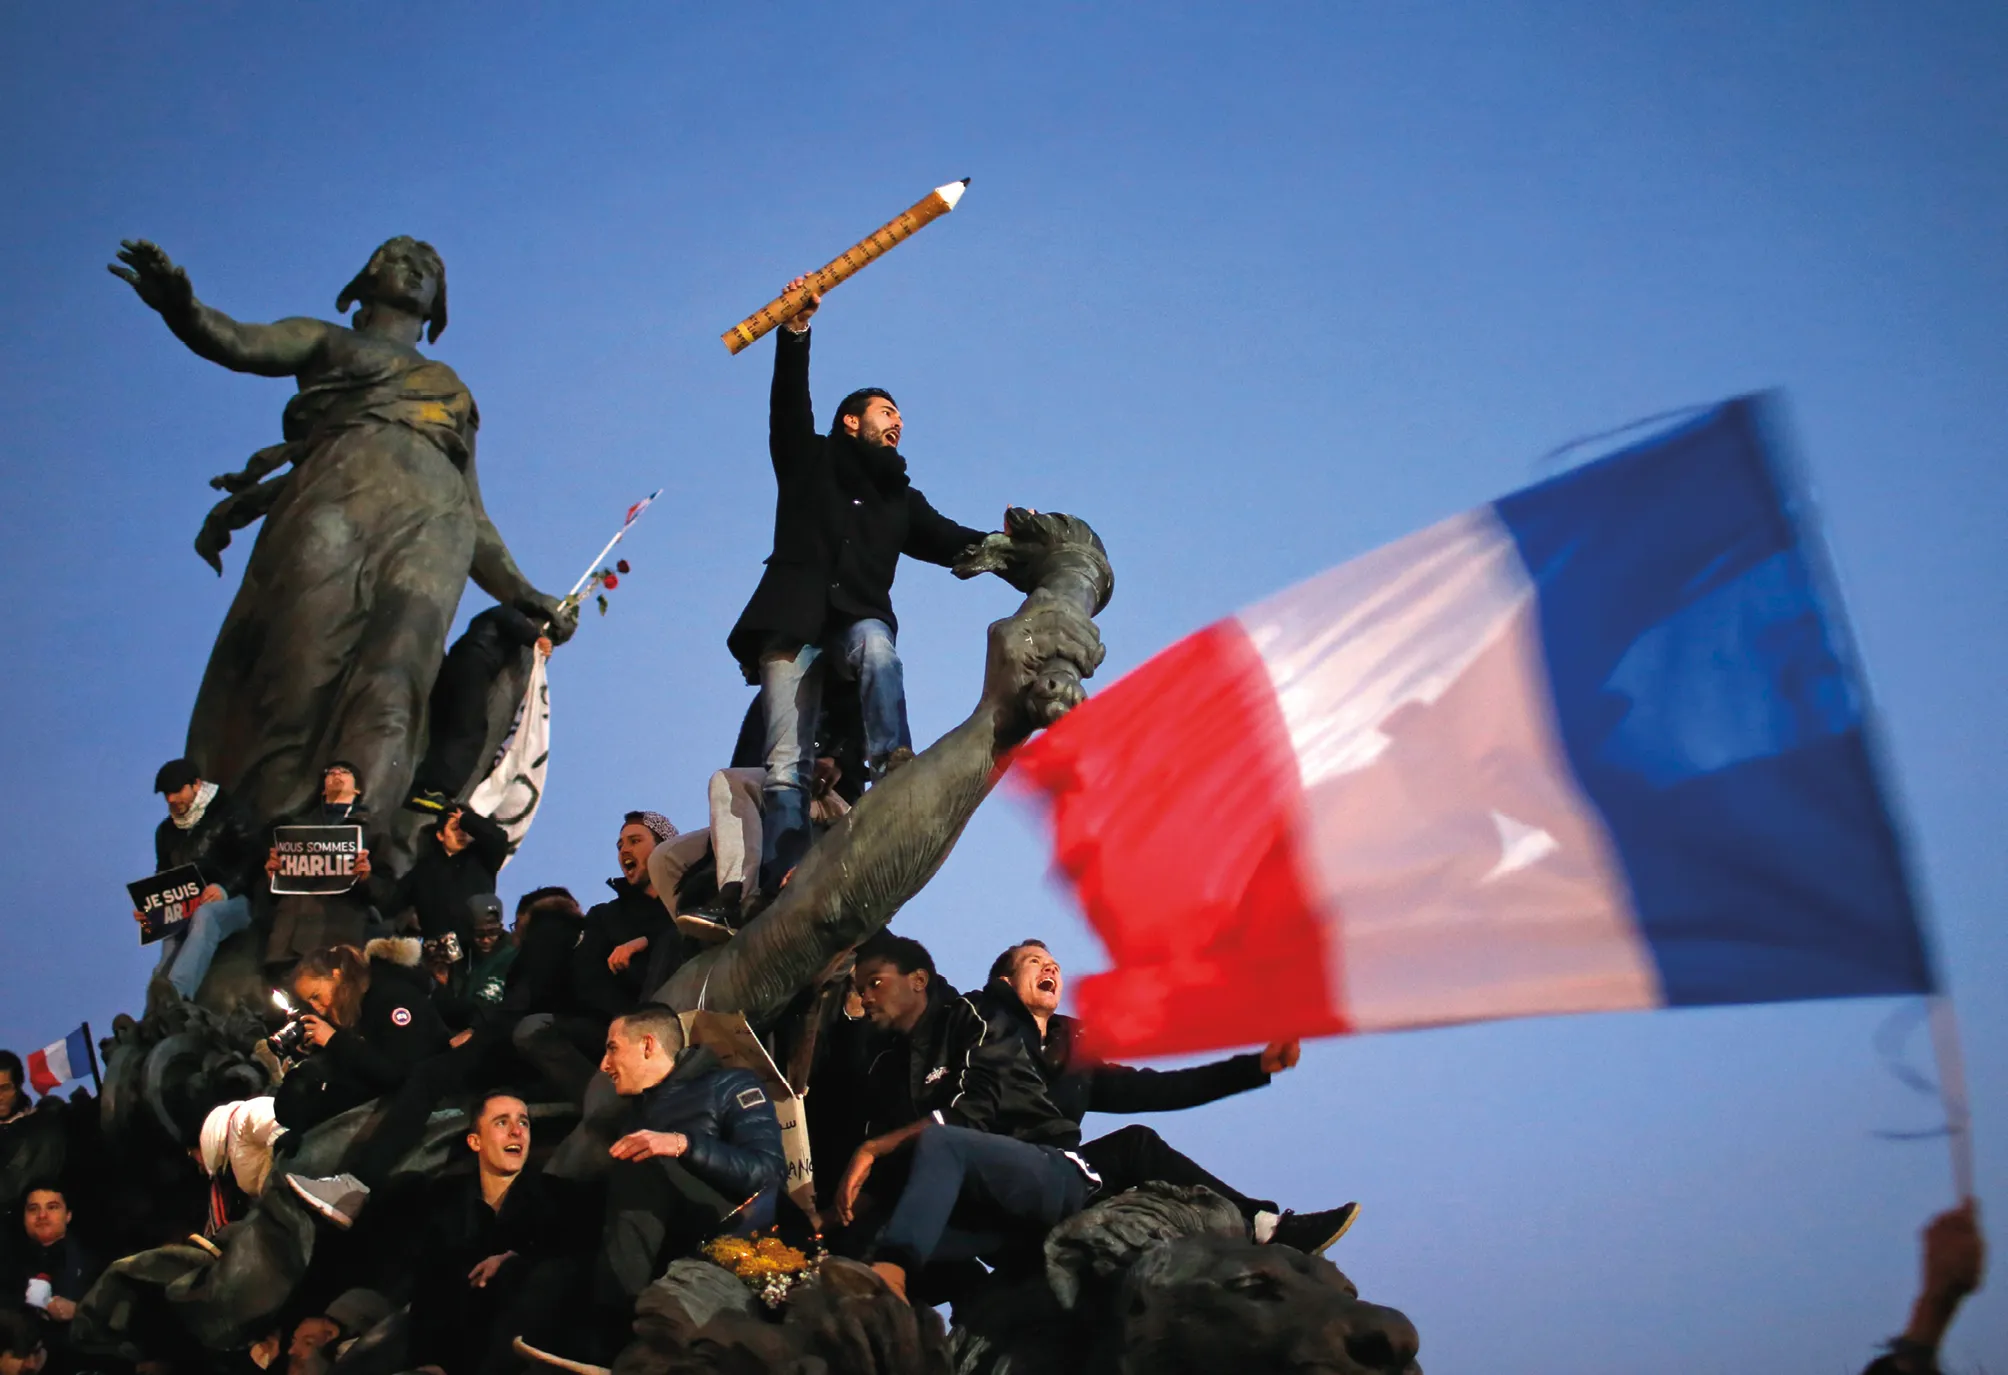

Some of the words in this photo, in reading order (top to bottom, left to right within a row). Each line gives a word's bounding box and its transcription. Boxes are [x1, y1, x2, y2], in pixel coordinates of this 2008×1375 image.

[278, 841, 303, 852] NOUS
[306, 841, 356, 852] SOMMES
[279, 854, 355, 876] CHARLIE
[143, 893, 163, 911] JE
[162, 882, 200, 904] SUIS
